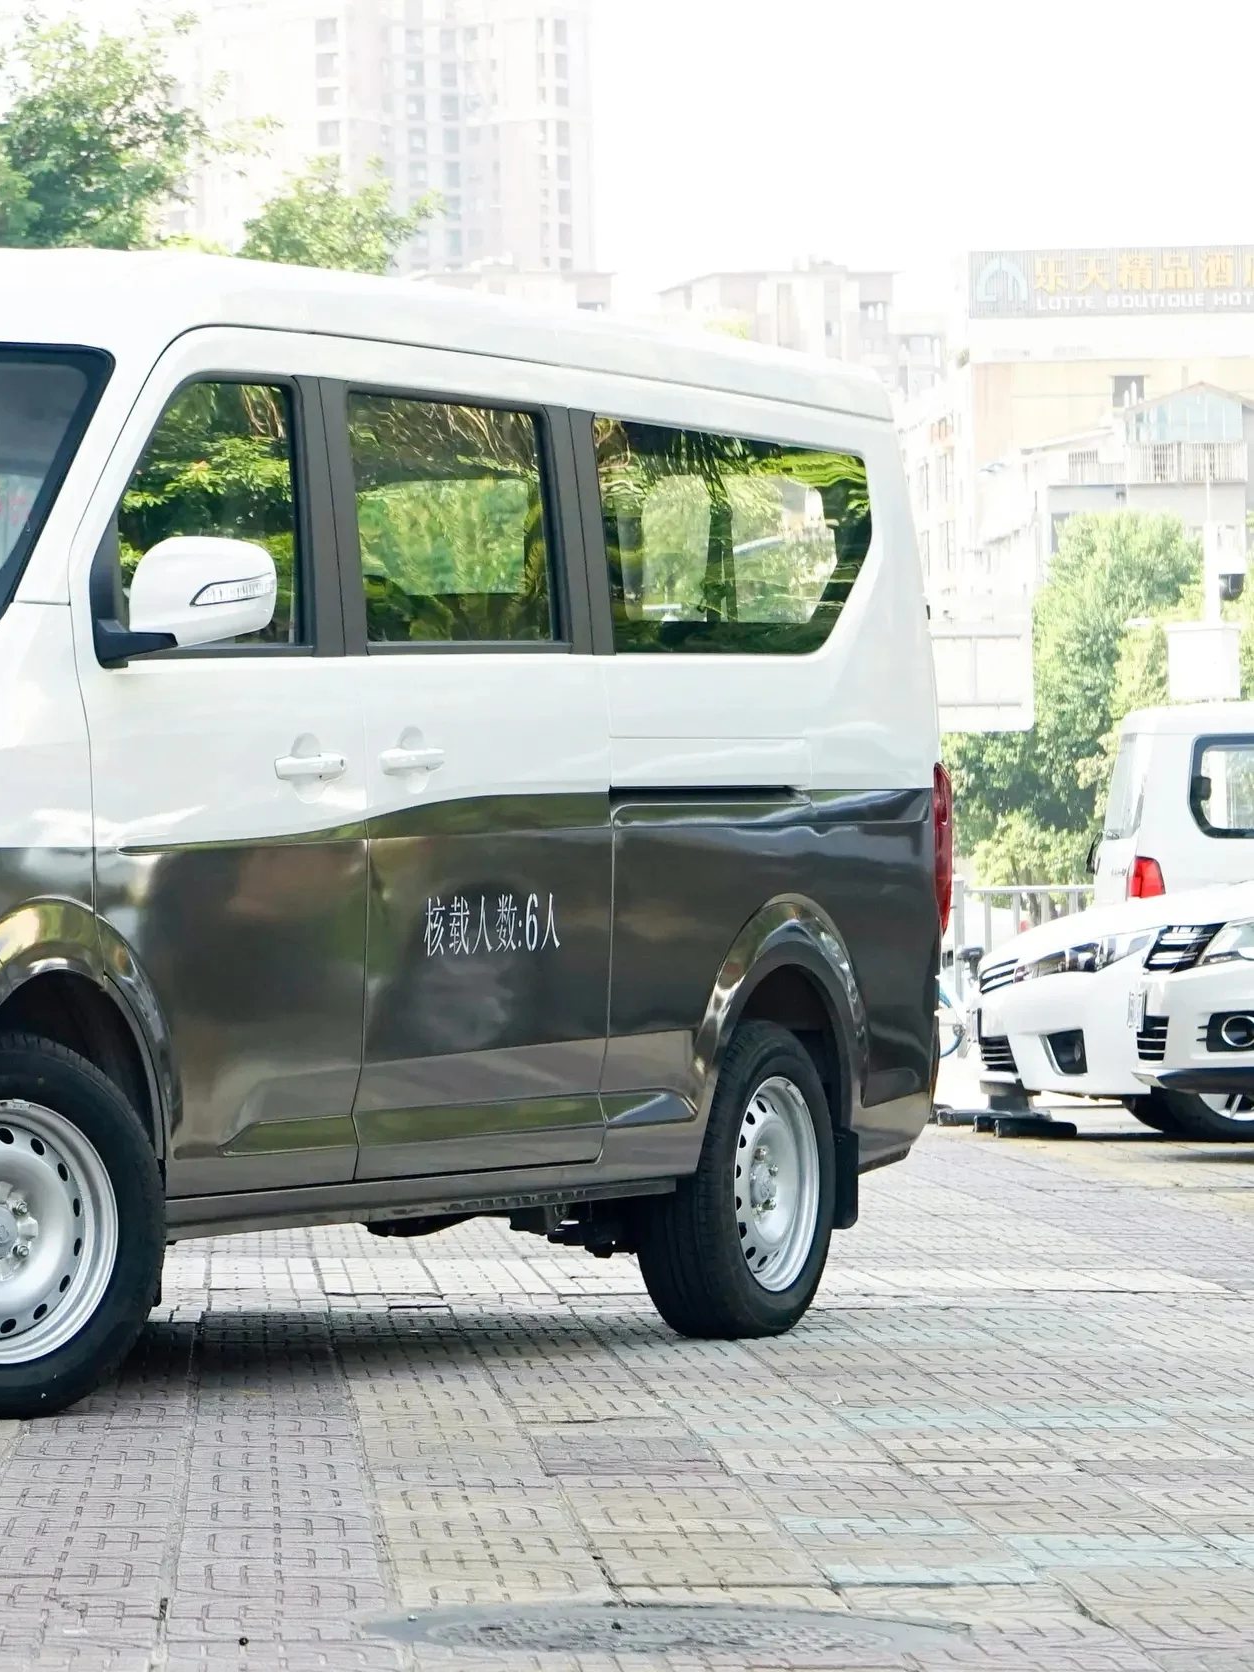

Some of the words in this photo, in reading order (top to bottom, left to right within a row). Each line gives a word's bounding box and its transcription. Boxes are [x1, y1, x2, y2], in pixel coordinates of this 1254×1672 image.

[1033, 252, 1254, 294] 乐天精品酒
[1036, 294, 1096, 311] LOTTE
[1106, 292, 1206, 309] BOUTIQUE
[423, 892, 561, 957] 核载人数:6人
